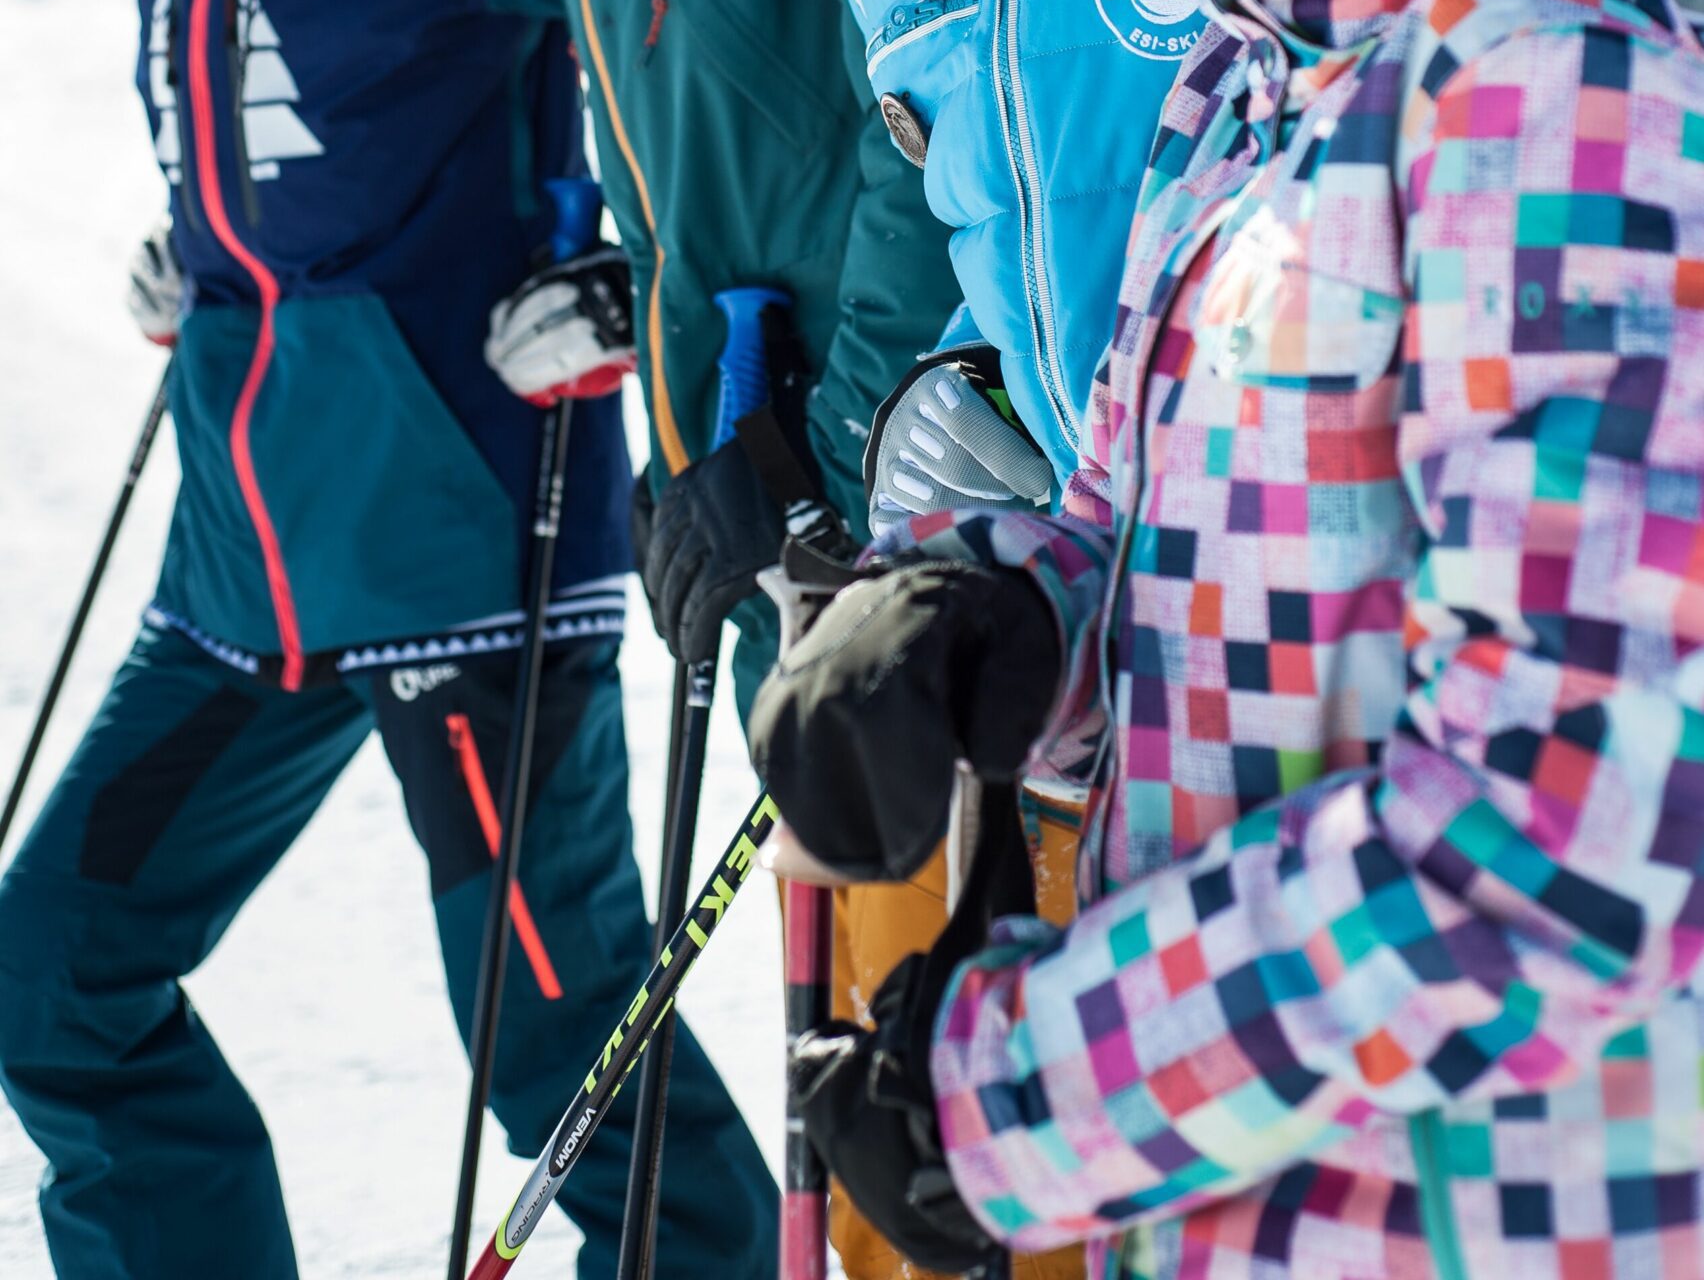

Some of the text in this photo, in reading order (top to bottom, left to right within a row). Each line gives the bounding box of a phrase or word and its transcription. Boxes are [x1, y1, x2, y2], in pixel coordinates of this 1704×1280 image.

[685, 793, 781, 950] LEKI
[555, 1107, 597, 1170] VENOM
[511, 1179, 552, 1243] RACING
